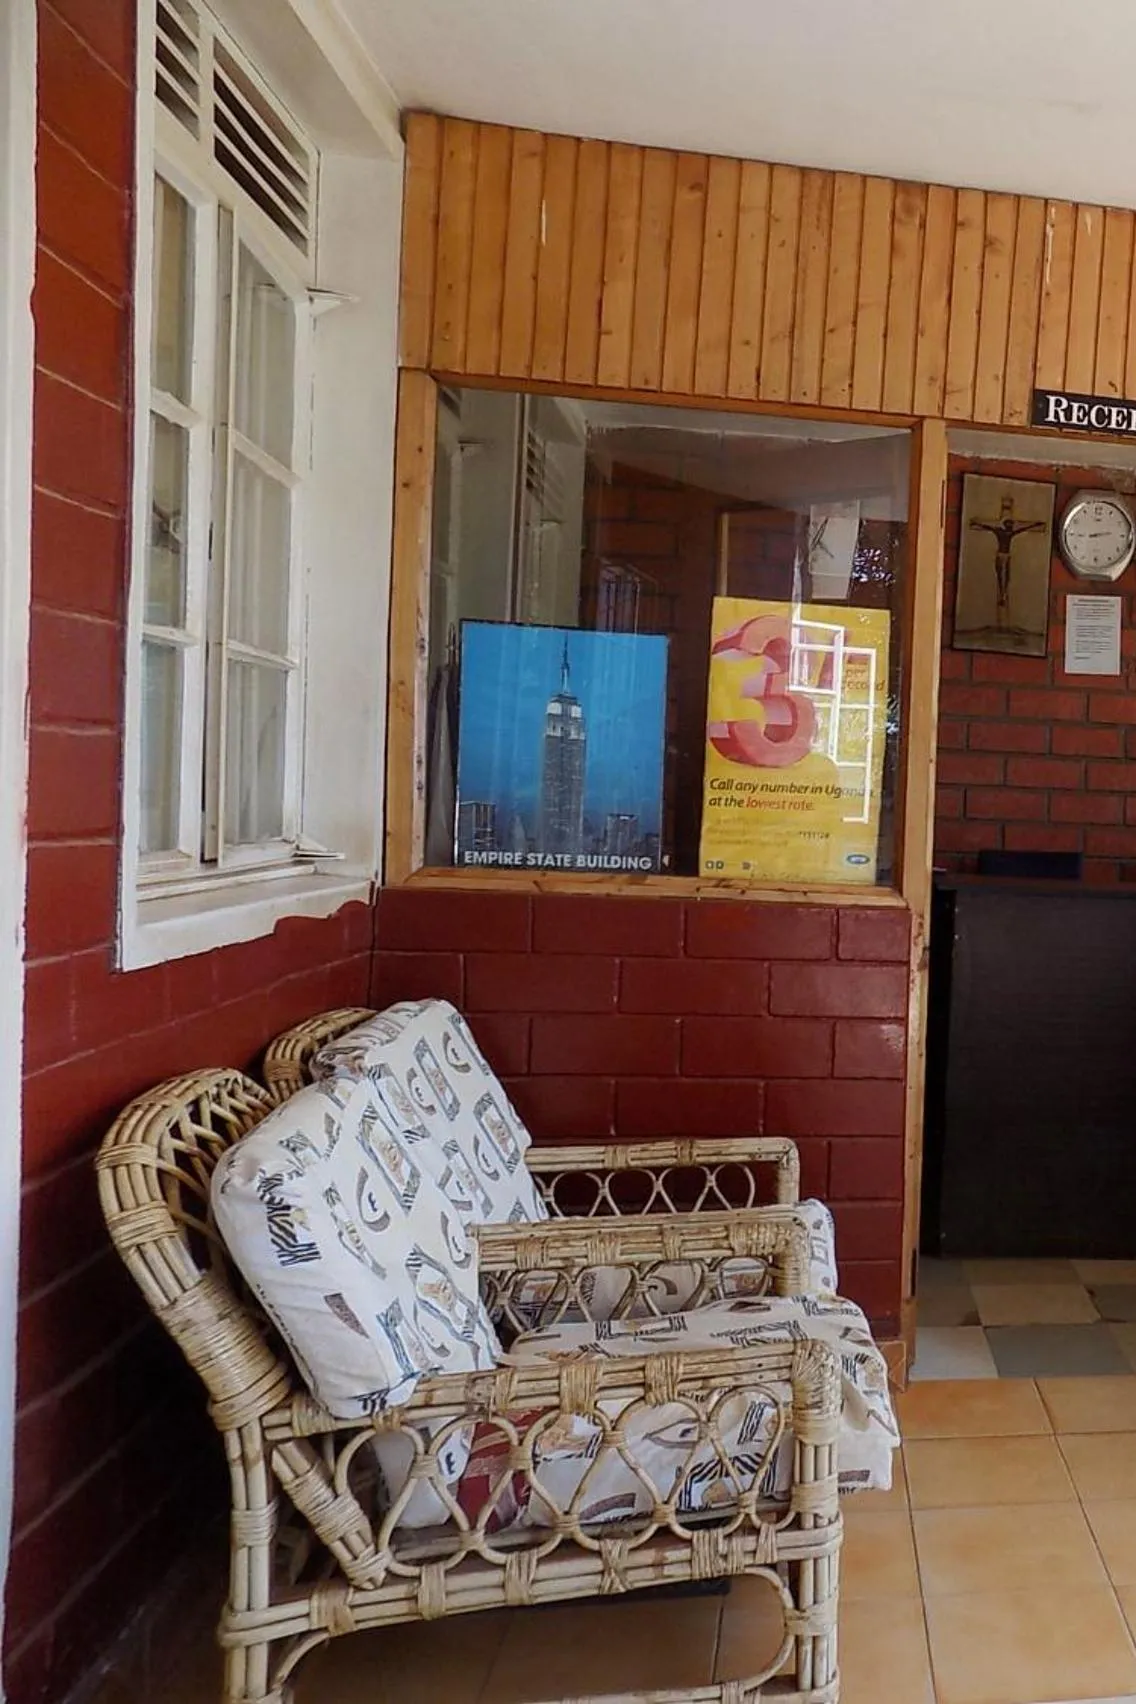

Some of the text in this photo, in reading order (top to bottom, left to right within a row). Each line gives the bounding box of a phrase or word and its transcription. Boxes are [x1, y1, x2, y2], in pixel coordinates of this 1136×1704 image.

[709, 778, 733, 791] Call
[735, 781, 758, 794] any
[760, 781, 809, 794] number
[811, 783, 823, 795] in
[708, 796, 723, 807] at
[724, 795, 745, 808] the
[745, 796, 785, 810] lowest
[464, 850, 652, 870] EMPIRE STATE BUILDING
